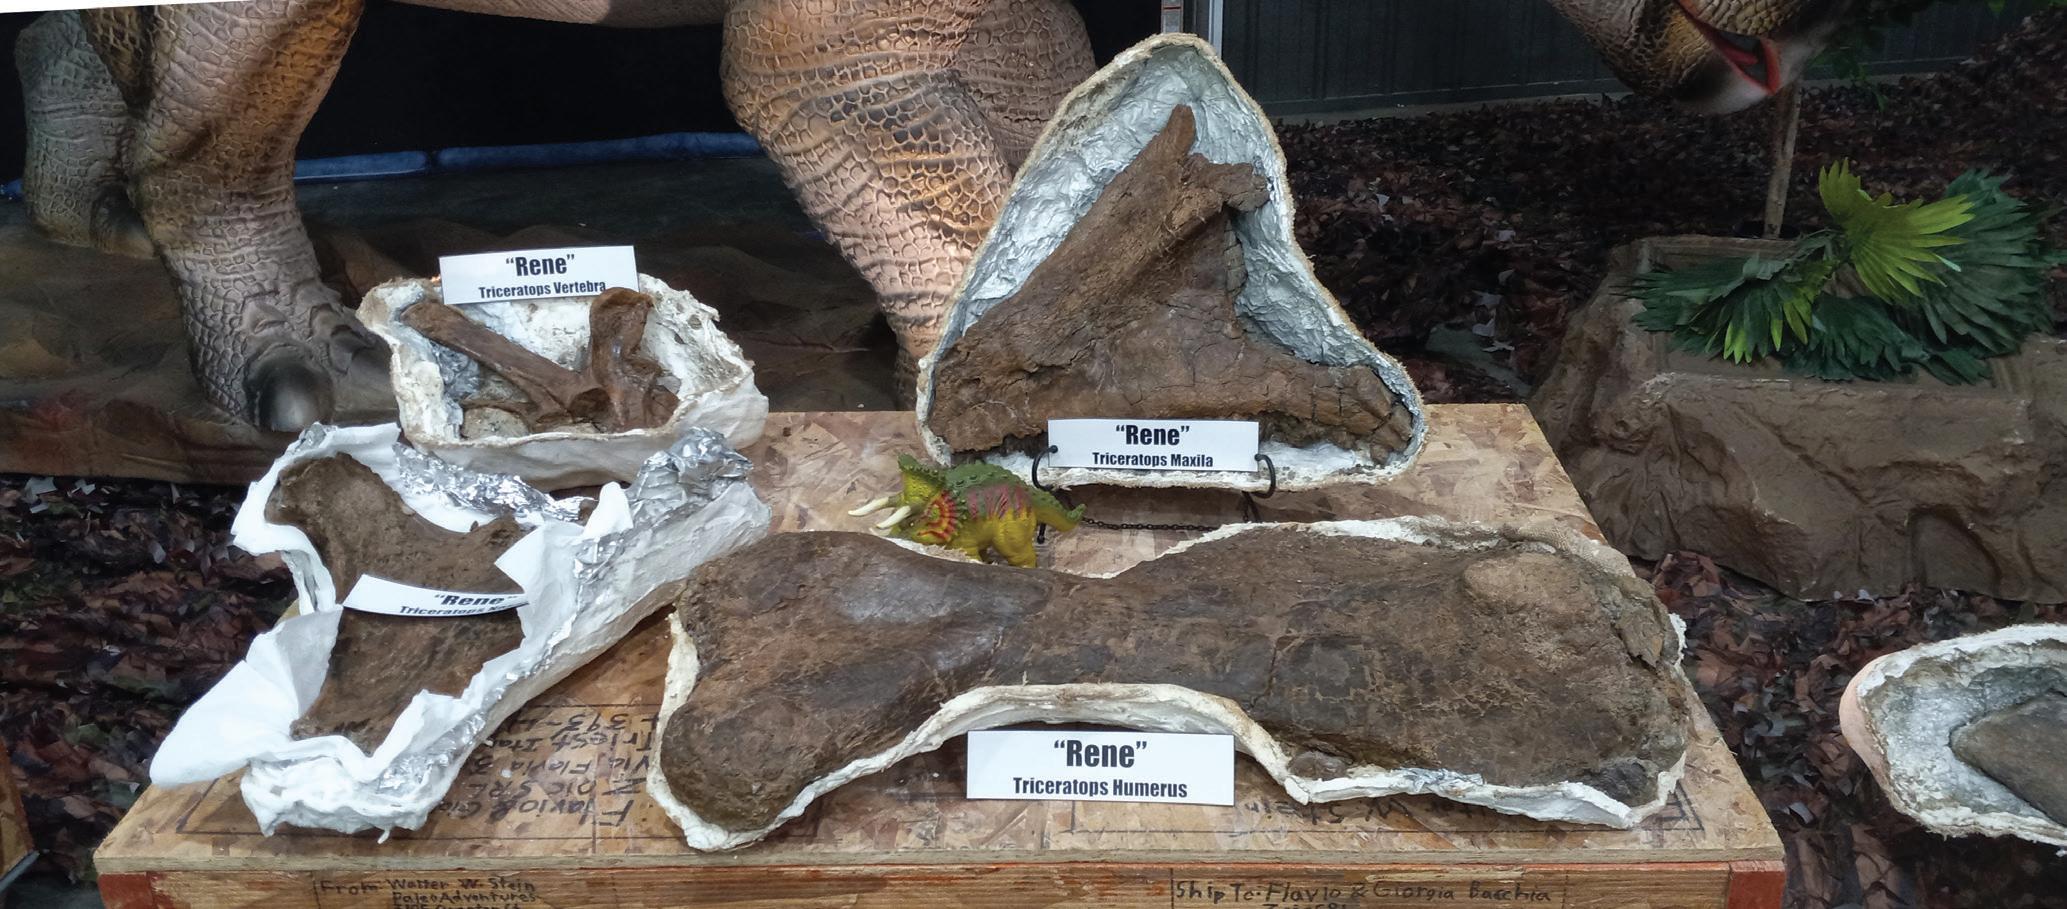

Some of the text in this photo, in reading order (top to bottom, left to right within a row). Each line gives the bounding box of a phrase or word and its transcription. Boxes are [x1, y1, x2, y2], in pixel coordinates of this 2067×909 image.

[505, 254, 576, 277] “Rene”
[478, 280, 607, 299] Triceratops Vertebra
[1115, 424, 1190, 445] “Rene”
[1092, 452, 1214, 468] Triceratops Maxila
[399, 605, 485, 615] Triceratops
[1054, 739, 1147, 768] “Rene”
[1013, 777, 1188, 798] Triceratops Humerus
[1176, 880, 1225, 904] Ship
[1264, 882, 1342, 902] Flavio
[1373, 881, 1455, 901] Giorgia
